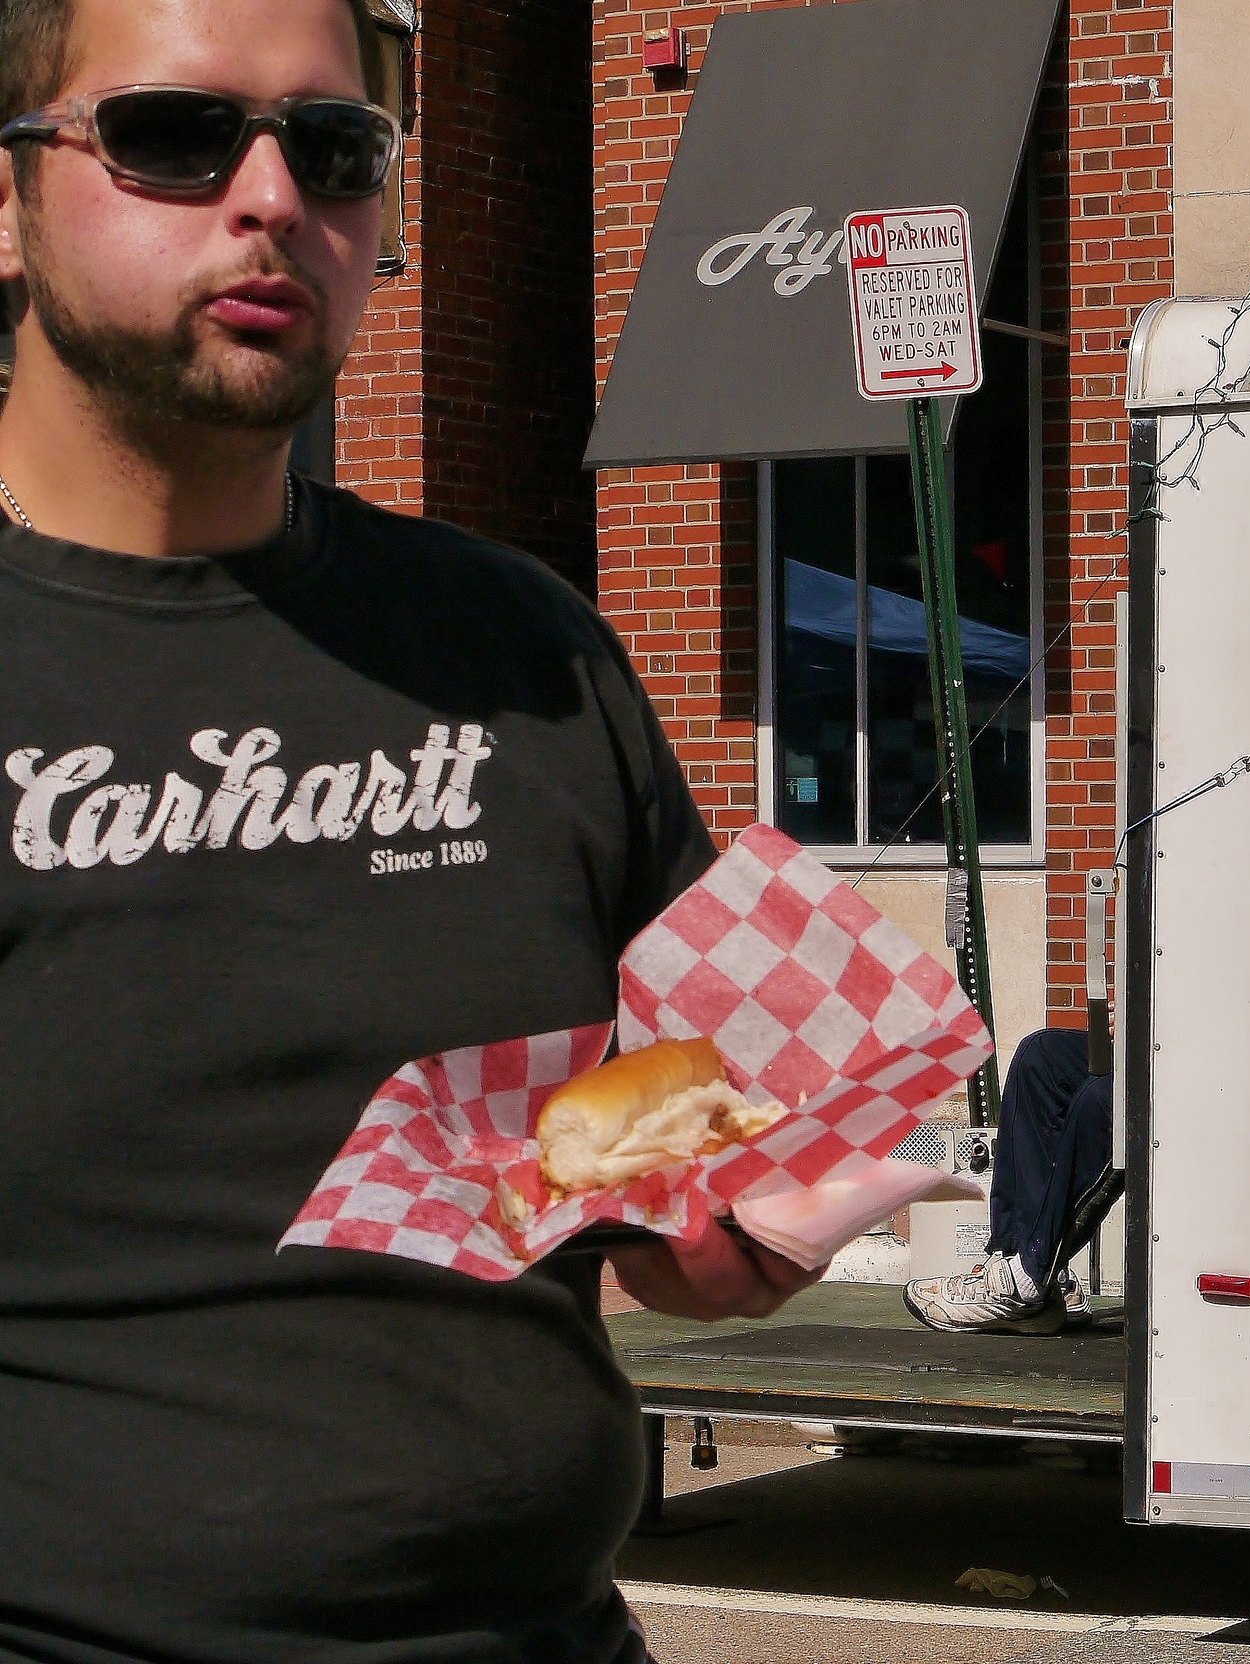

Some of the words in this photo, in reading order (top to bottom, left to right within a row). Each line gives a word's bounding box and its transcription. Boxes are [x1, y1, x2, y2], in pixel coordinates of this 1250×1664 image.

[697, 206, 849, 296] Ay
[850, 224, 883, 259] NO
[887, 226, 960, 251] PARKING
[861, 268, 931, 294] RESERVED
[936, 266, 963, 289] FOR
[864, 297, 902, 320] VALET
[909, 292, 965, 317] PARKING
[872, 323, 901, 341] 6PM
[908, 321, 925, 339] TO
[932, 319, 962, 337] 2AM
[879, 340, 957, 361] WED-SAT
[4, 722, 493, 871] Carhartt
[370, 848, 434, 875] Since
[439, 840, 488, 866] 1889
